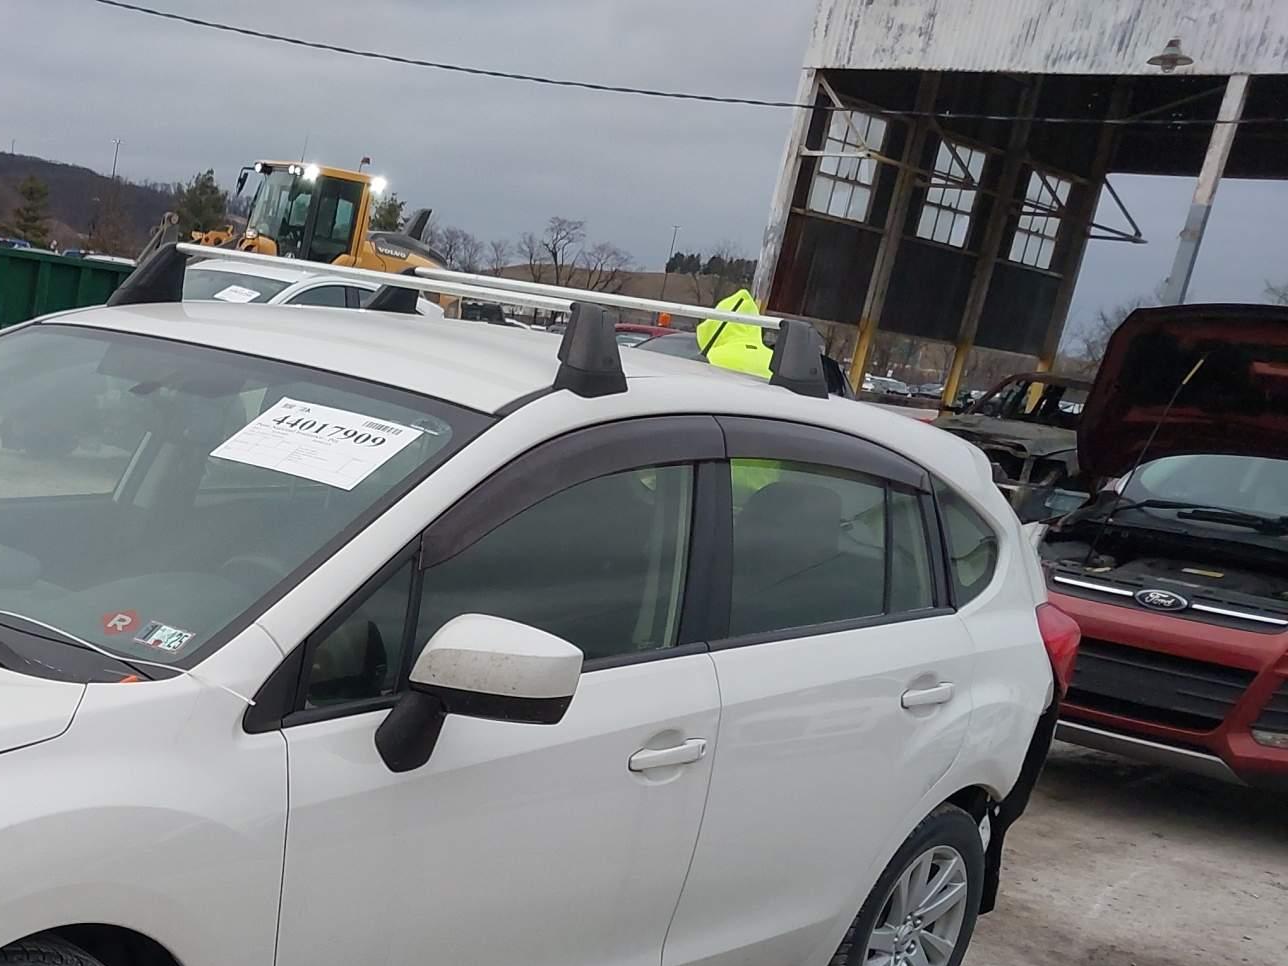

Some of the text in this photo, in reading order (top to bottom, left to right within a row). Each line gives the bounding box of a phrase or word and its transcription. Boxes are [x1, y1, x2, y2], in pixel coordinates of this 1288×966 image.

[377, 247, 406, 258] VOLVO
[272, 415, 386, 447] 44017909
[1144, 592, 1175, 607] Ford
[106, 613, 132, 632] R
